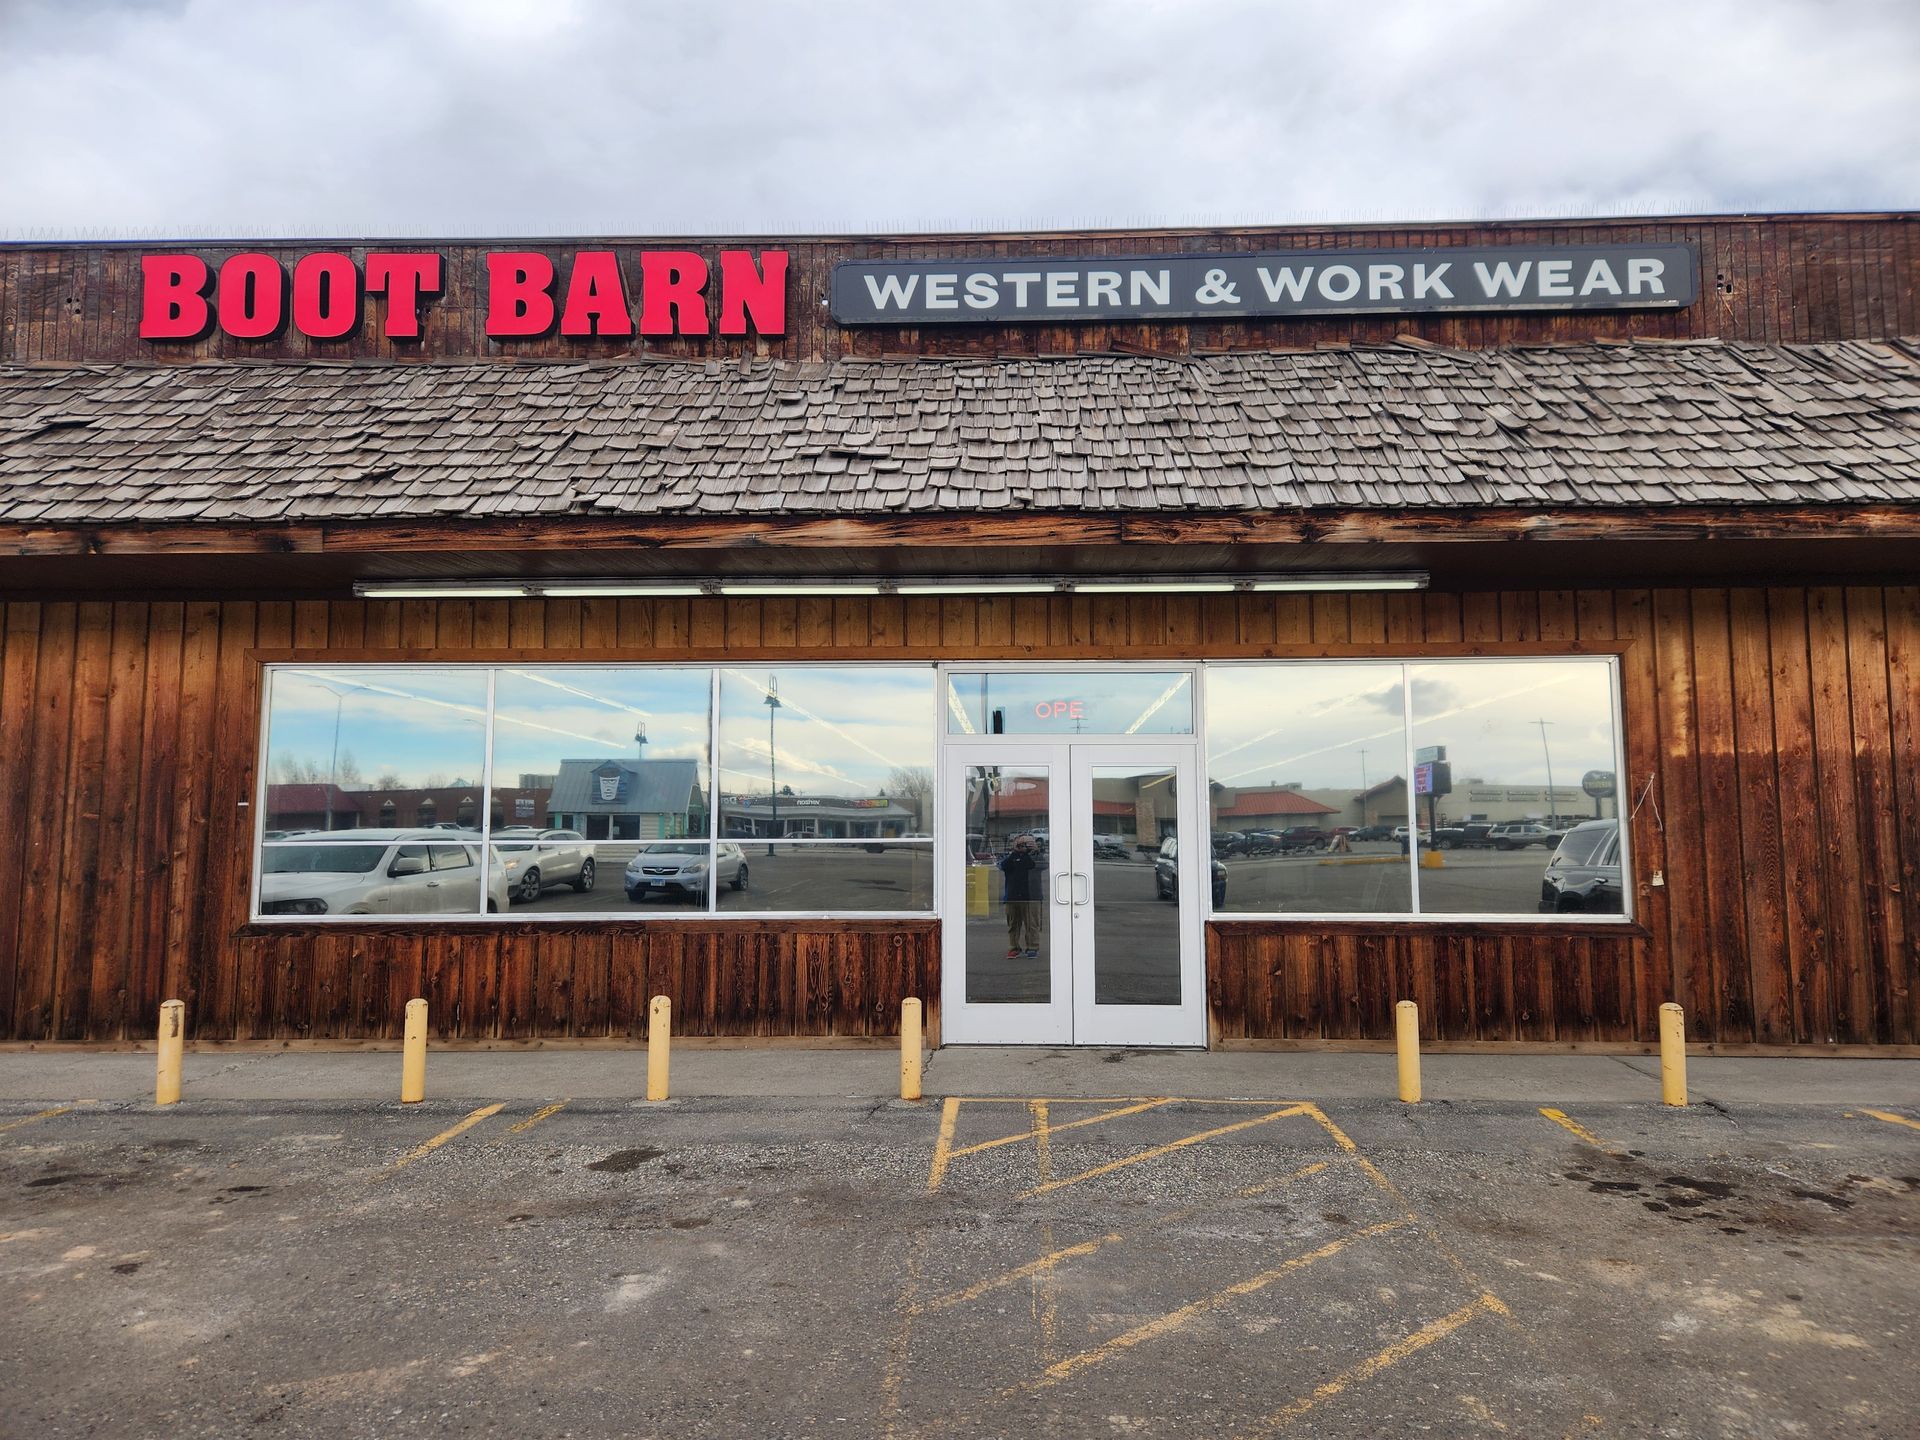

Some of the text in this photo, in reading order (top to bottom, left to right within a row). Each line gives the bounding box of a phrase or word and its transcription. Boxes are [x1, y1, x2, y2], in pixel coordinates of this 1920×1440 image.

[140, 250, 789, 338] BOOT BARN
[863, 257, 1666, 310] WESTERN & WORK WEAR
